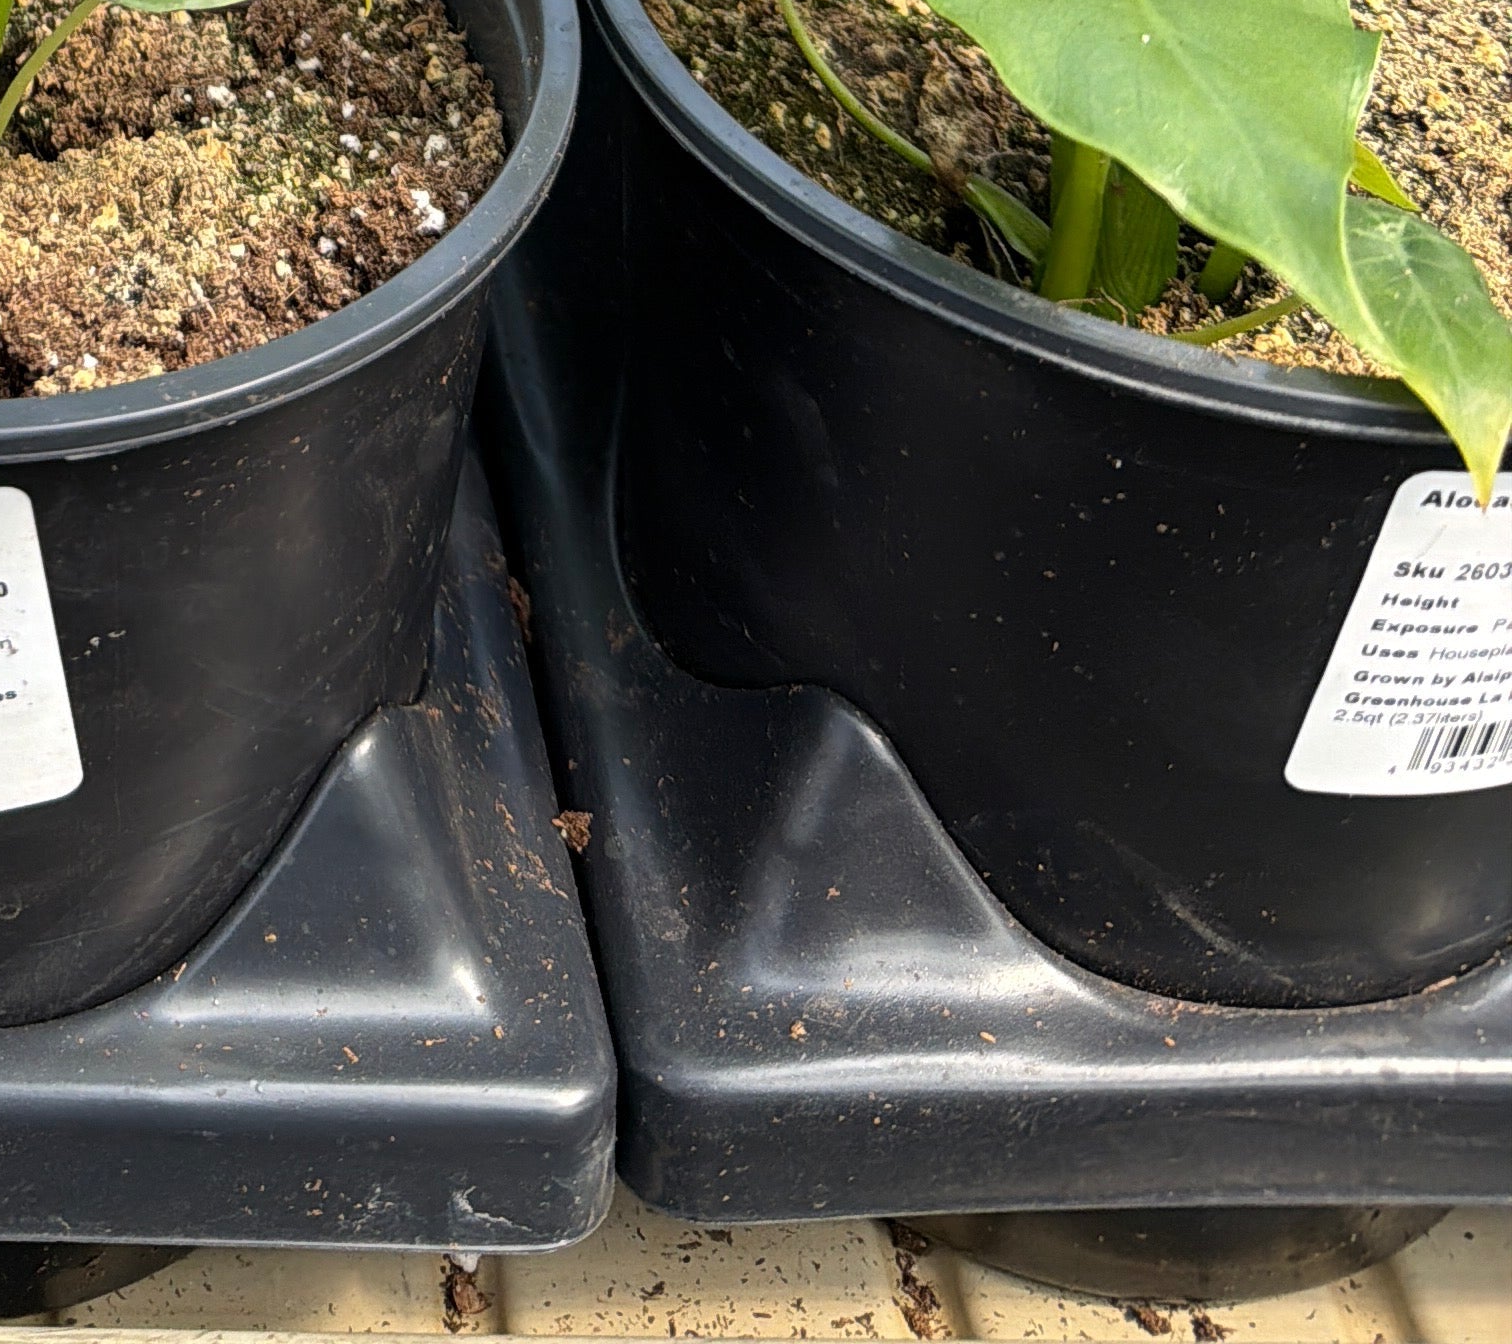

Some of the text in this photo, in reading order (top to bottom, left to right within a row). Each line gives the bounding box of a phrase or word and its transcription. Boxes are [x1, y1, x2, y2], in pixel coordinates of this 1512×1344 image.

[1420, 490, 1512, 508] Aloa
[1393, 561, 1445, 579] Sku
[1381, 593, 1460, 610] Height
[1371, 618, 1478, 636] Exposure
[1361, 644, 1419, 659] Uses
[1353, 670, 1424, 685] Grown
[1431, 673, 1457, 688] by
[1344, 692, 1472, 707] Greenhouse
[1478, 692, 1502, 704] La
[1333, 709, 1384, 726] 2.5qt
